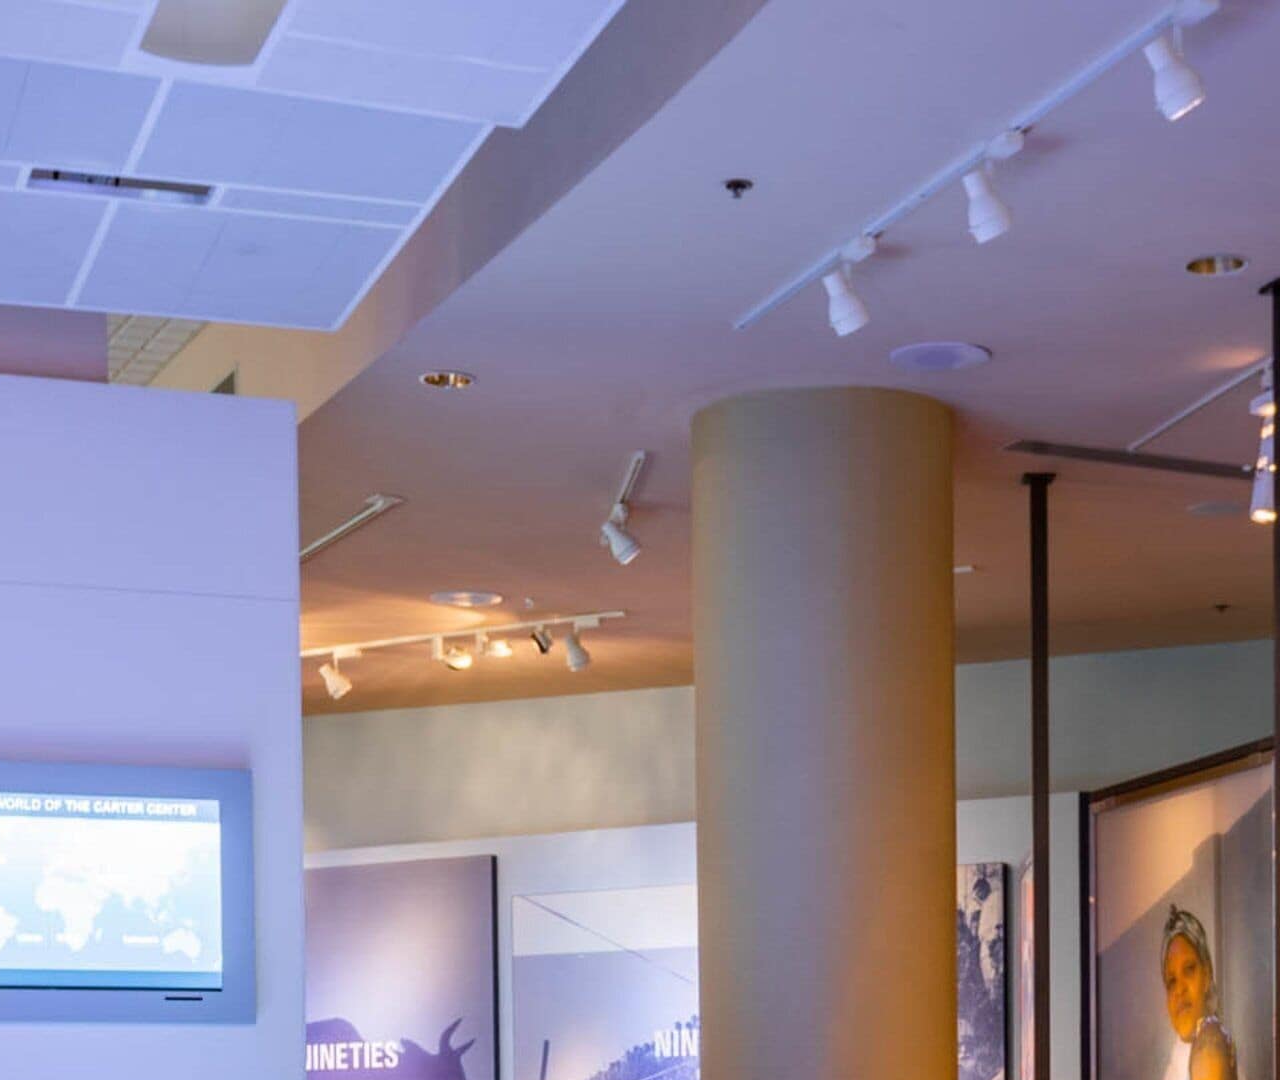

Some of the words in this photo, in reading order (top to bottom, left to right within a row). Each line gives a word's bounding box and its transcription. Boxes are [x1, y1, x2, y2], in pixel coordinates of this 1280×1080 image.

[44, 799, 62, 812] OF
[65, 800, 91, 813] THE
[93, 800, 144, 815] CARTER
[146, 802, 198, 817] CENTER
